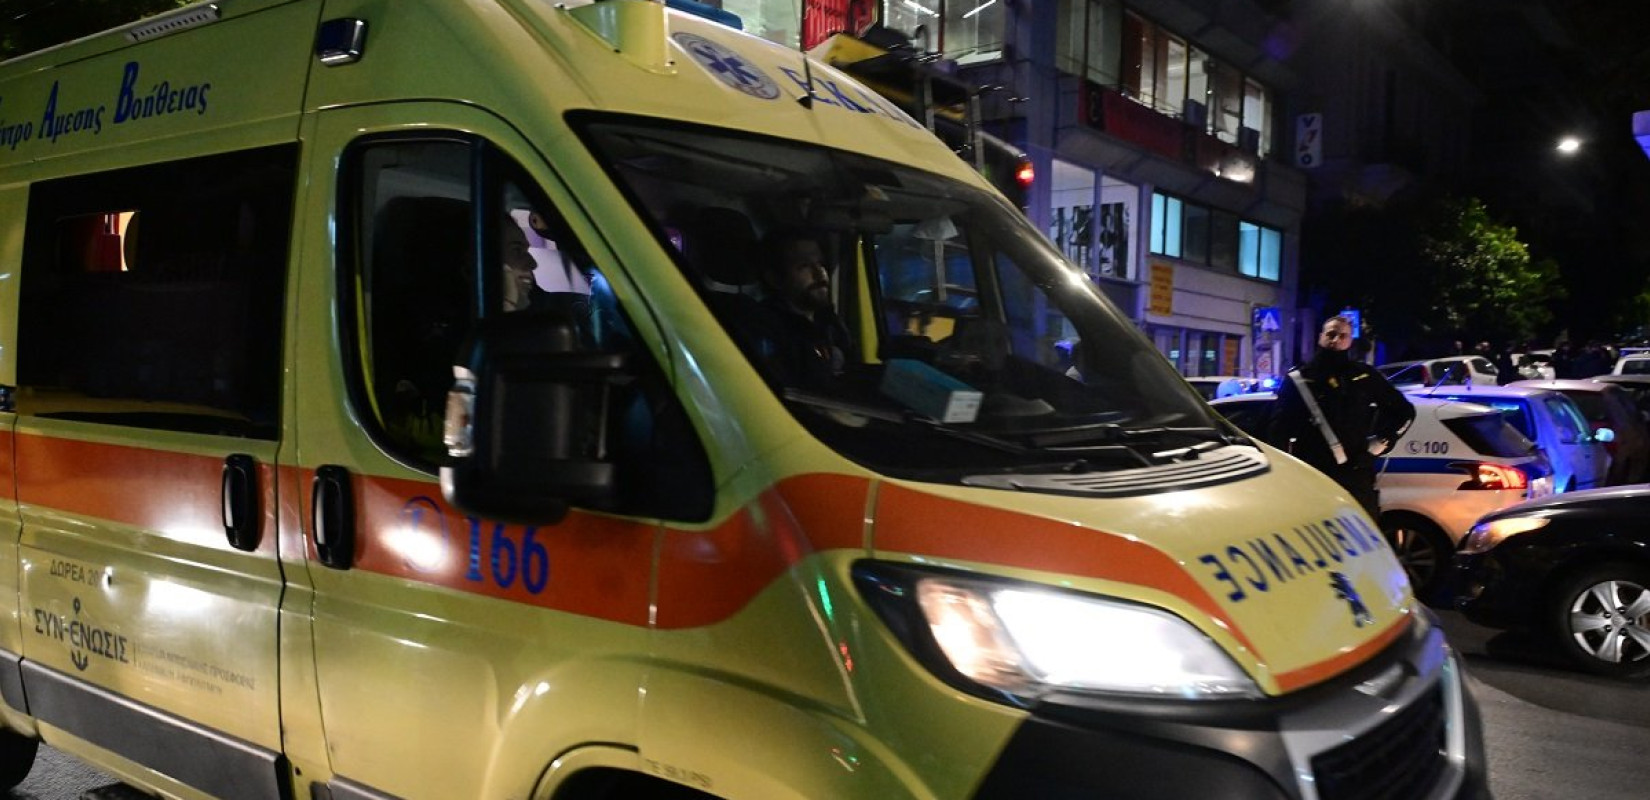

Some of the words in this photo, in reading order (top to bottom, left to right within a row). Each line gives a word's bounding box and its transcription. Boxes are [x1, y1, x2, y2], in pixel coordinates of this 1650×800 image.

[0, 119, 33, 150] ντρο
[113, 61, 211, 125] Βοήθειας
[1424, 441, 1449, 454] 100
[50, 559, 86, 583] ΔΩΡΕΑ
[465, 514, 549, 595] 166
